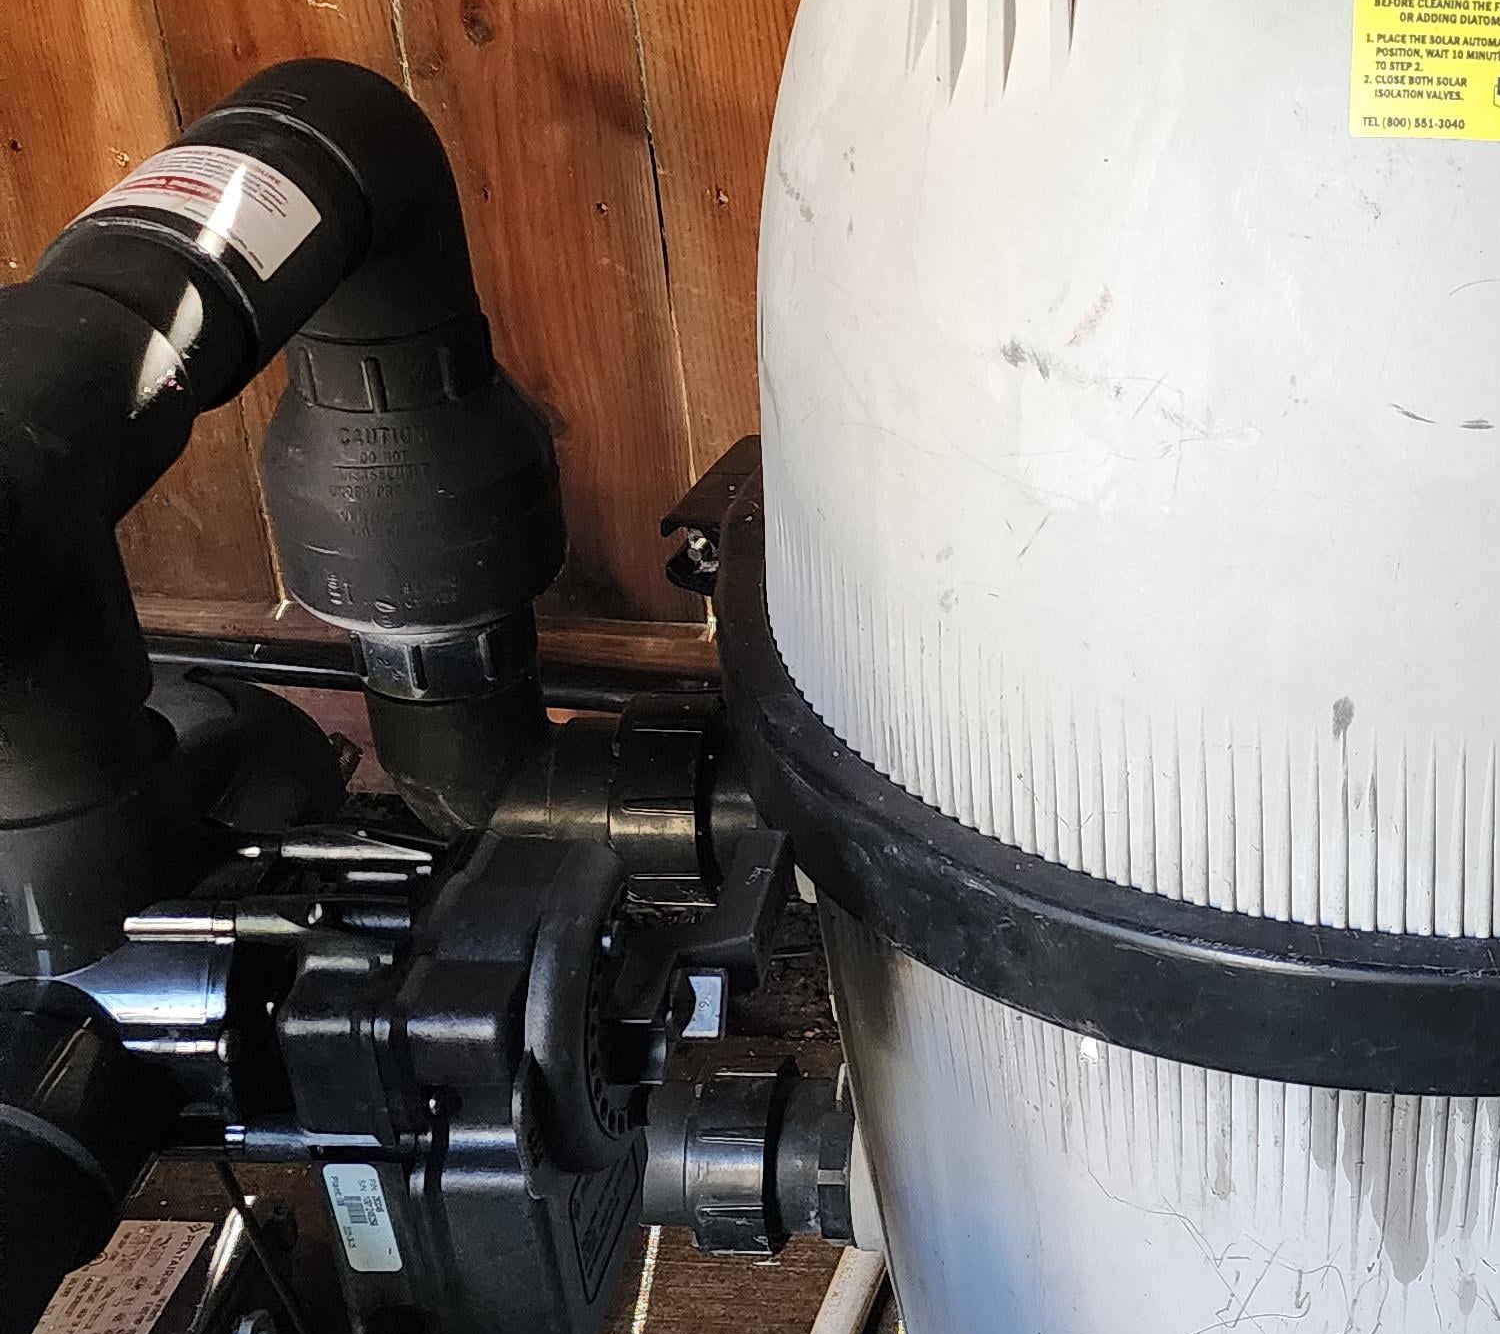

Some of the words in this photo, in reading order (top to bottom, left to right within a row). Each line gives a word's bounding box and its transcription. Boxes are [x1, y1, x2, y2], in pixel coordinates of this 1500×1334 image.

[1417, 0, 1469, 10] CLEANING
[1472, 1, 1492, 11] THE
[1400, 12, 1414, 22] OR
[1416, 13, 1457, 24] ADDING
[1366, 33, 1374, 43] 1.
[1377, 34, 1407, 44] PLACE
[1409, 35, 1427, 44] THE
[1429, 35, 1460, 46] SOLAR
[1375, 47, 1423, 59] POSITION,
[1426, 49, 1449, 59] WAIT
[1452, 50, 1463, 59] 10
[1375, 61, 1386, 70] TO
[1390, 61, 1412, 71] STEP
[1414, 62, 1423, 72] 2.
[1363, 75, 1372, 84] 2.
[1375, 75, 1406, 85] CLOSE
[1408, 76, 1433, 85] BOTH
[1436, 77, 1467, 87] SOLAR
[1375, 89, 1424, 99] ISOLATION
[1426, 90, 1464, 101] VALVES.
[1382, 117, 1411, 130] (800)
[1414, 118, 1465, 130] 551-3040
[162, 1233, 194, 1279] PENTAIR
